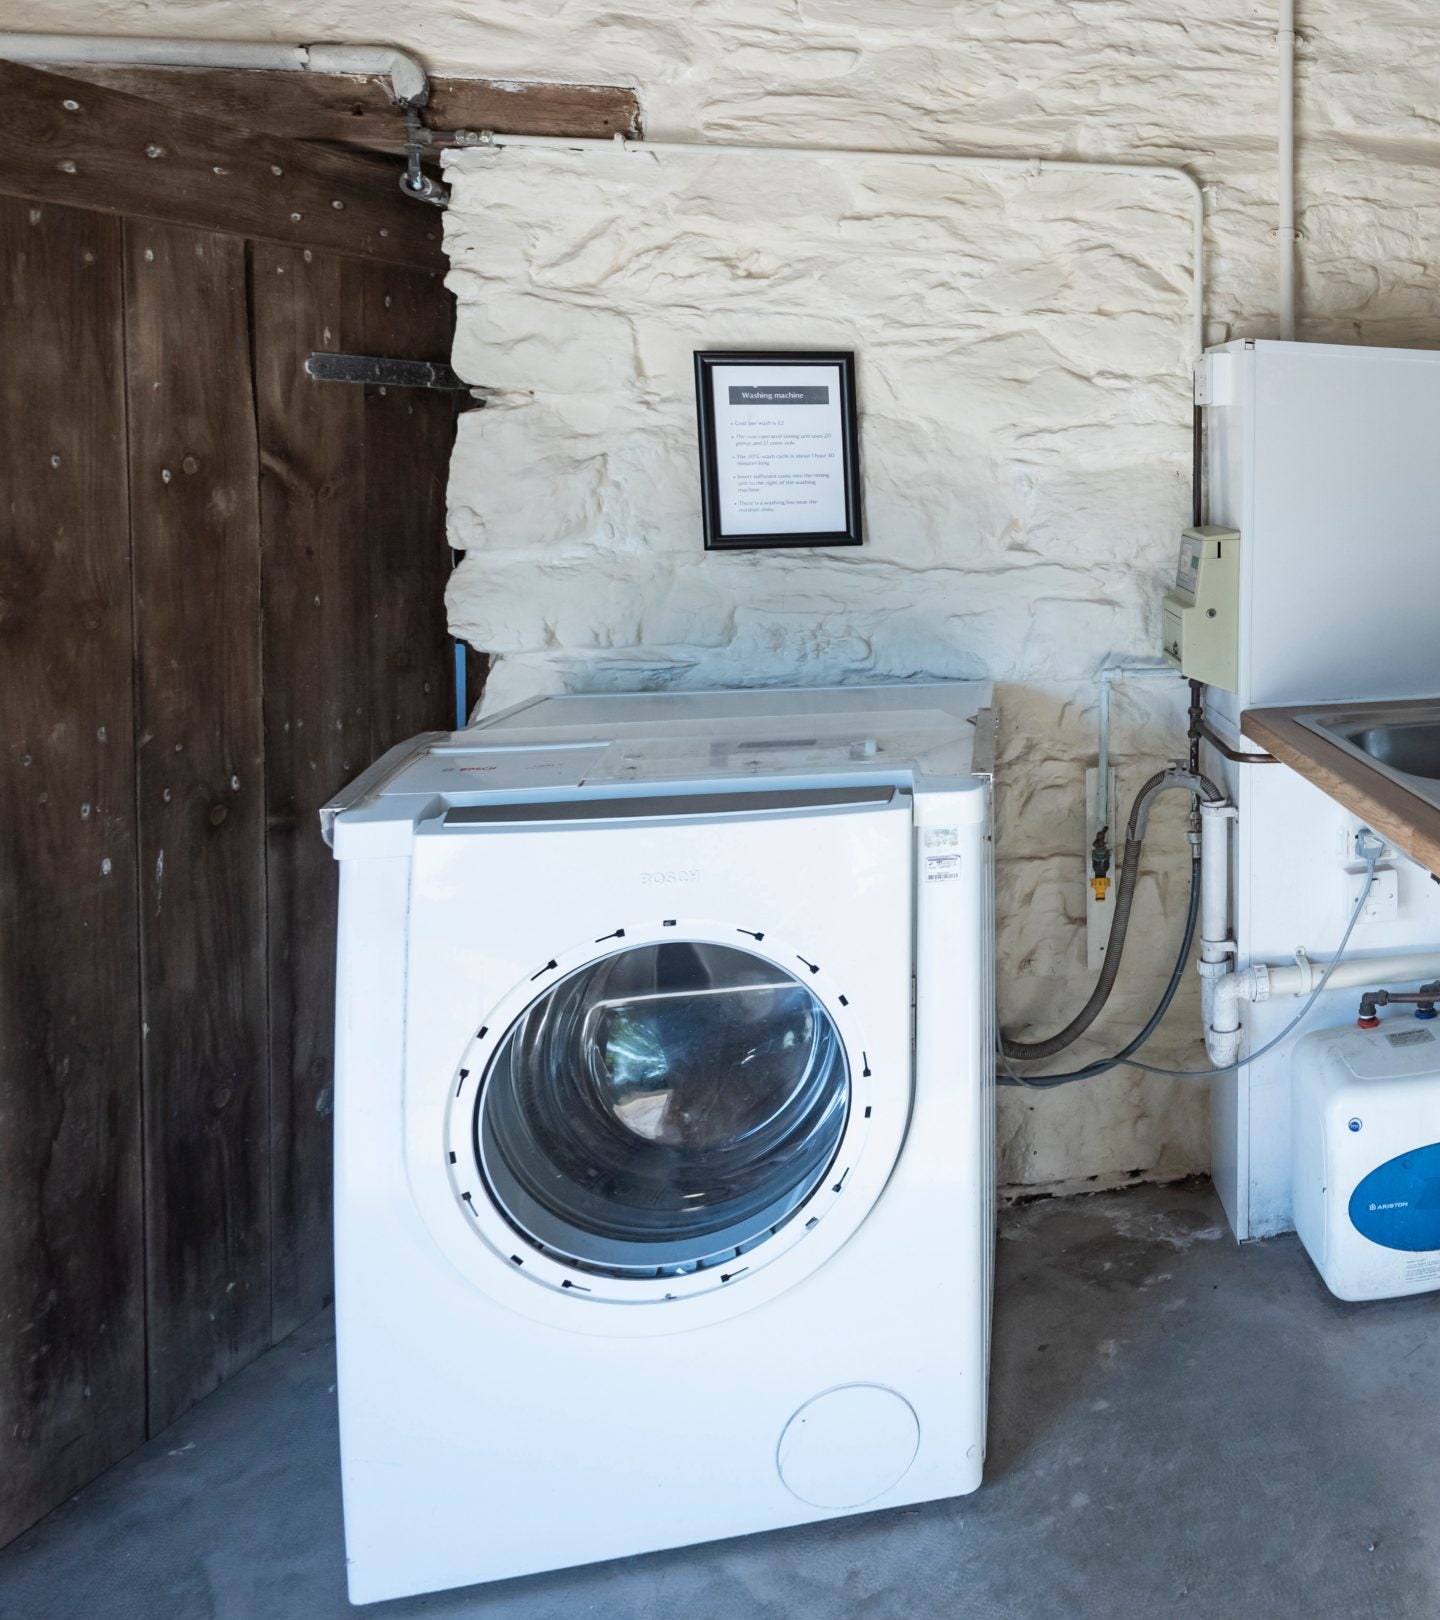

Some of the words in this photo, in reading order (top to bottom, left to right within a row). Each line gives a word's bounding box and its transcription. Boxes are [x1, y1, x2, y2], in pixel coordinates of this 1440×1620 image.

[741, 391, 773, 400] Washing
[774, 391, 804, 399] machine
[640, 868, 702, 888] BOSCH
[1377, 1201, 1408, 1210] ARISTON
